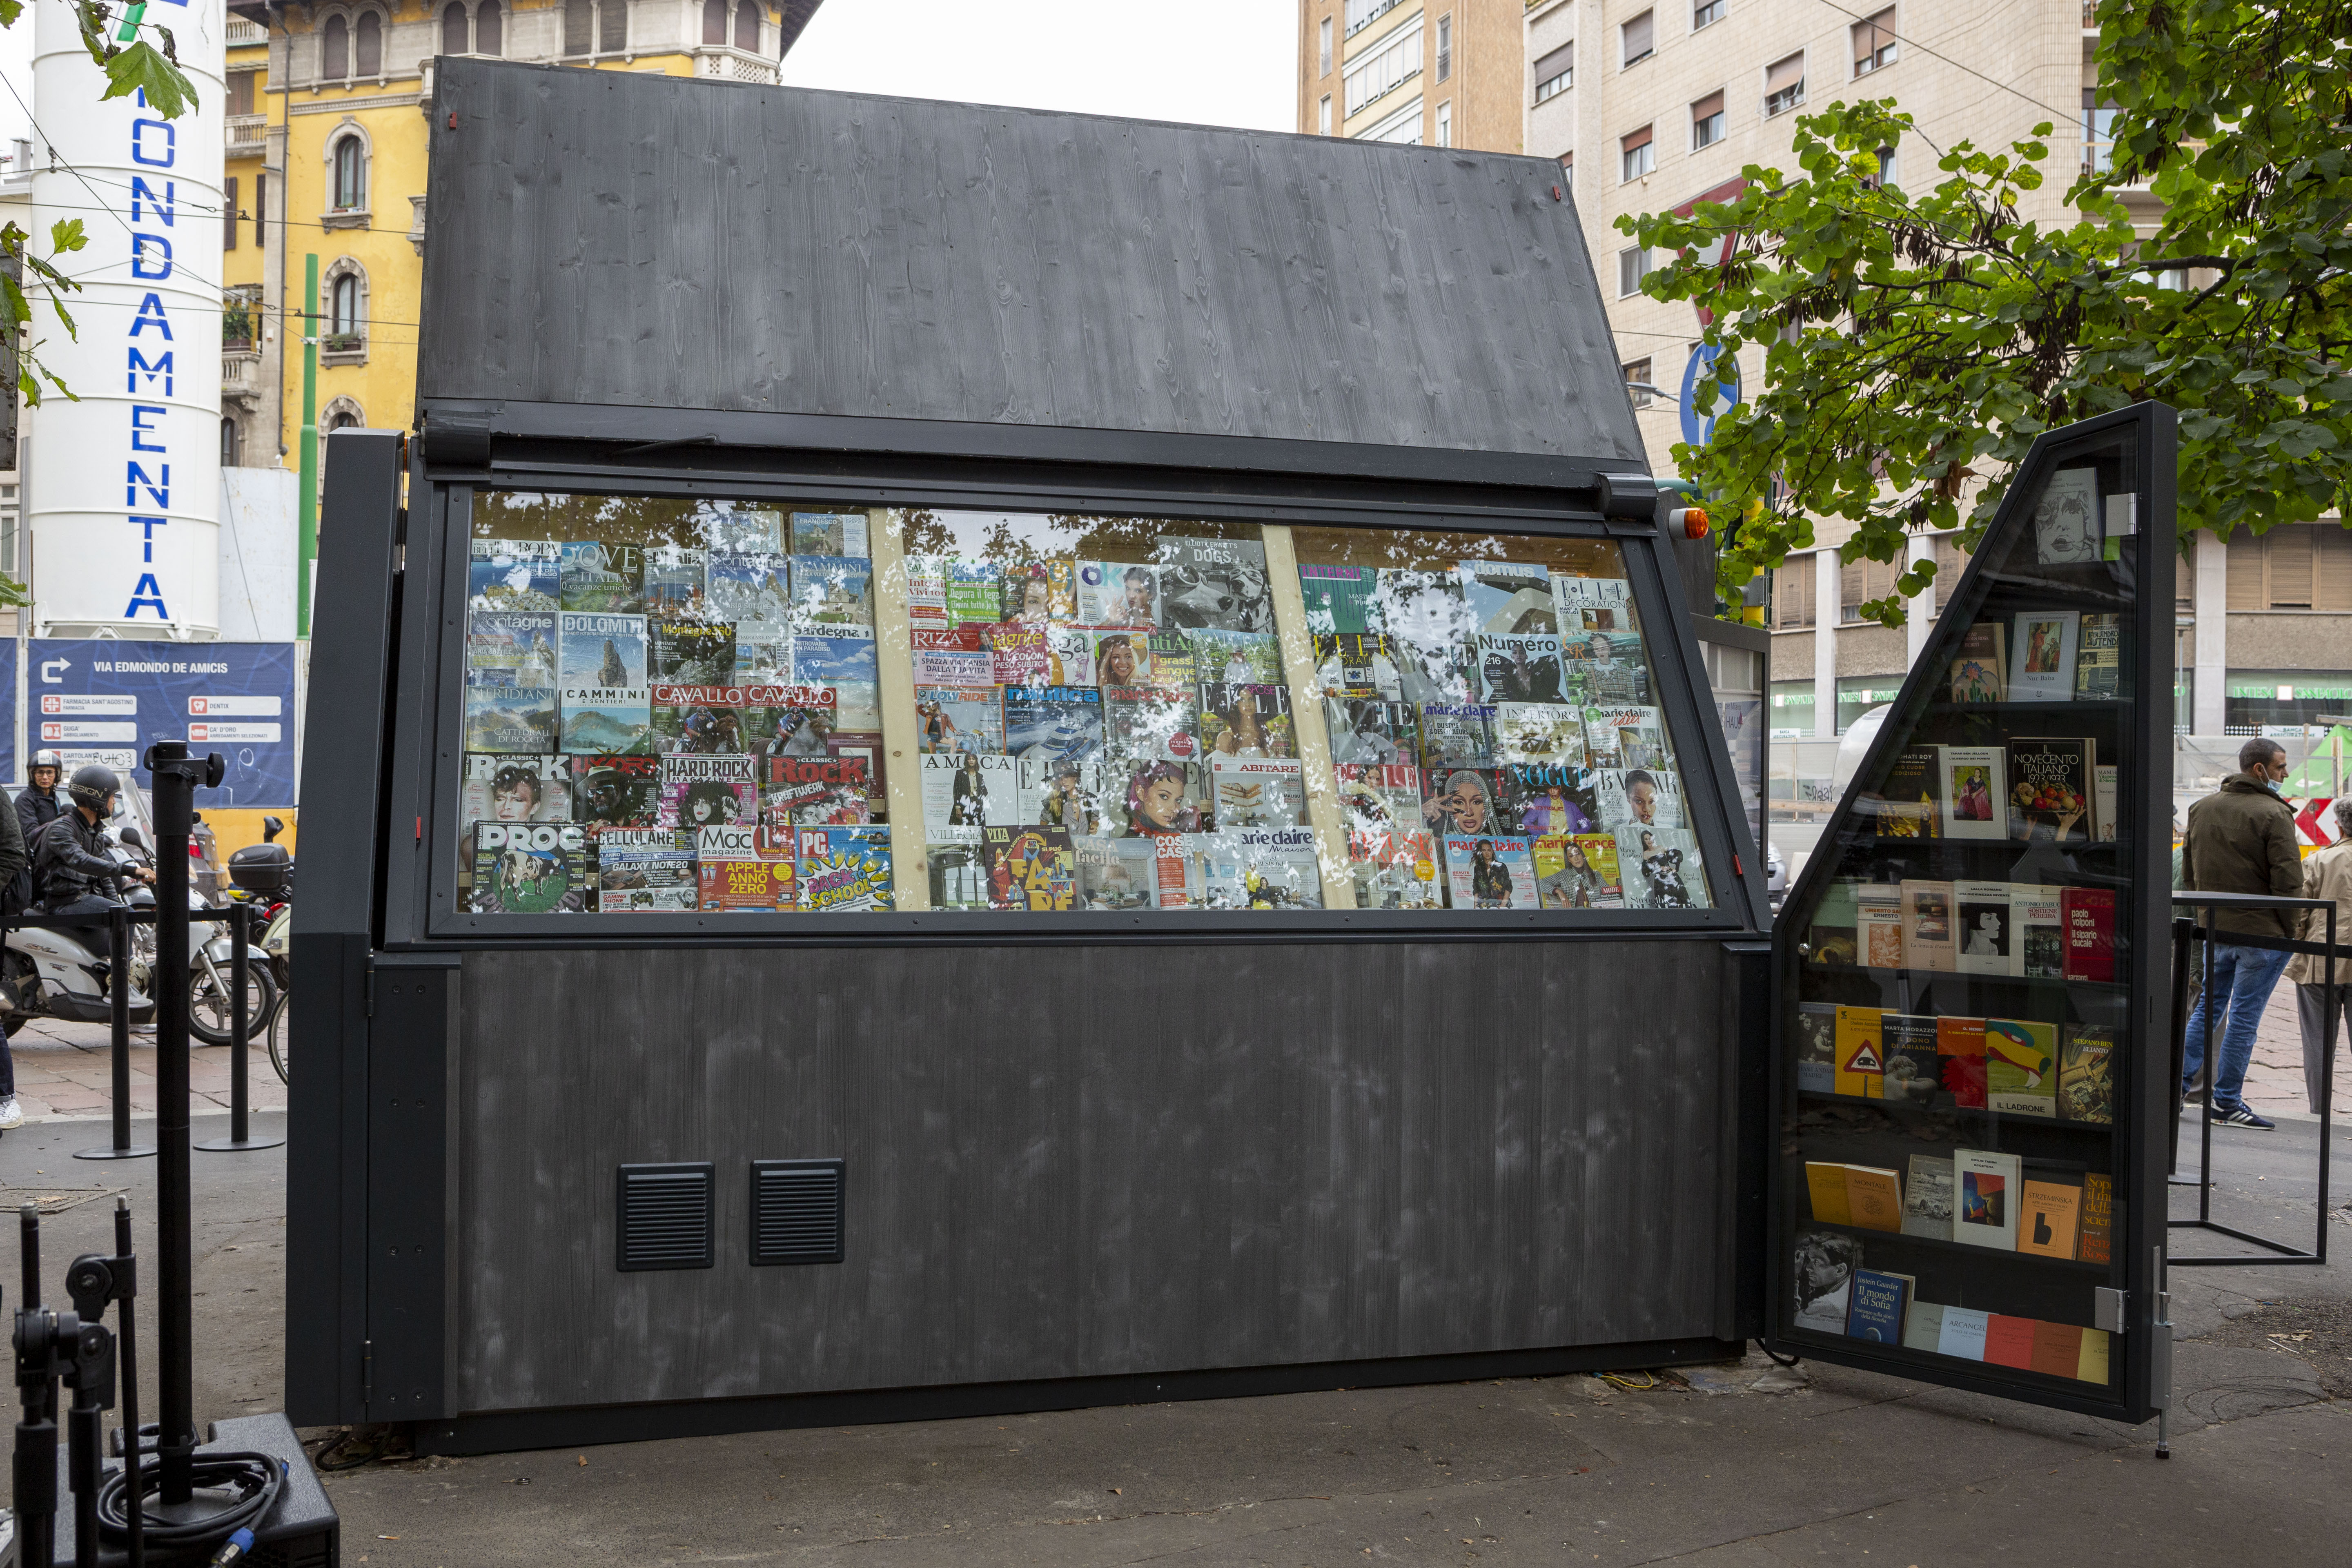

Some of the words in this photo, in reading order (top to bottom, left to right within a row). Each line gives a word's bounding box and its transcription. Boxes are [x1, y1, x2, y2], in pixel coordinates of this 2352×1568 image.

[124, 87, 175, 619] ONDAMENTA
[1194, 548, 1231, 563] DOGS
[1301, 566, 1361, 579] INTERNI
[1474, 562, 1535, 578] domus
[580, 572, 630, 583] ITALIA
[1561, 580, 1625, 601] ELLE
[1564, 599, 1626, 608] DECORATION
[913, 632, 963, 646] RIZA
[1314, 634, 1390, 657] ELLE
[1479, 634, 1557, 652] Numéro
[1486, 657, 1501, 665] 216
[94, 662, 112, 672] VIA
[116, 662, 169, 673] EDMONDO
[173, 663, 187, 673] DE
[189, 663, 228, 674] AMICIS
[567, 689, 644, 699] CAMMINI
[655, 687, 742, 703] CAVALLO
[928, 690, 989, 702] LOWRIDE
[1008, 687, 1099, 702] nautica
[2233, 687, 2273, 699] INTESA
[1425, 704, 1460, 716] marie
[1463, 704, 1495, 717] claire
[1506, 708, 1575, 720] INTERIORS
[2043, 744, 2051, 754] IL
[924, 755, 1012, 770] AMCA
[2015, 755, 2078, 764] NOVECENTO
[1239, 764, 1299, 773] ABITARE
[2024, 764, 2070, 774] ITALIANO
[68, 783, 103, 798] DESIGN
[770, 781, 826, 804] KRAFTWERK
[482, 825, 585, 852] PROG
[599, 831, 674, 845] CELLULARE
[702, 827, 751, 849] Mac
[986, 828, 1009, 840] VITA
[1272, 828, 1313, 845] claire
[802, 833, 826, 854] PC
[1074, 837, 1119, 853] CASA
[1156, 835, 1192, 847] COSE
[1075, 849, 1120, 864] facile
[1156, 846, 1194, 858] CASA
[612, 862, 649, 871] GALAXY
[652, 861, 688, 869] NOTE20
[725, 862, 770, 873] APPLE
[728, 873, 768, 883] ANNO
[807, 869, 855, 893] BACK
[850, 869, 866, 881] TO
[730, 883, 766, 894] ZERO
[810, 878, 875, 908] SCHOOL
[2071, 909, 2089, 918] paolo
[2072, 918, 2095, 927] volponi
[2072, 929, 2076, 938] il
[2076, 930, 2097, 940] sipario
[2072, 938, 2092, 948] ducale
[2006, 1103, 2045, 1113] LADRONE
[1854, 1179, 1886, 1189] MONTALE
[2028, 1192, 2072, 1205] STRZEMIŃSKA
[1857, 1276, 1875, 1286] Jostein
[1877, 1280, 1898, 1290] Gaarder
[1858, 1286, 1864, 1295] Il
[1867, 1289, 1895, 1302] mondo
[1860, 1297, 1869, 1305] di
[1871, 1298, 1890, 1310] Sofia
[1855, 1307, 1873, 1316] Romanzo
[1883, 1312, 1894, 1320] storia
[1871, 1315, 1886, 1323] filosofia
